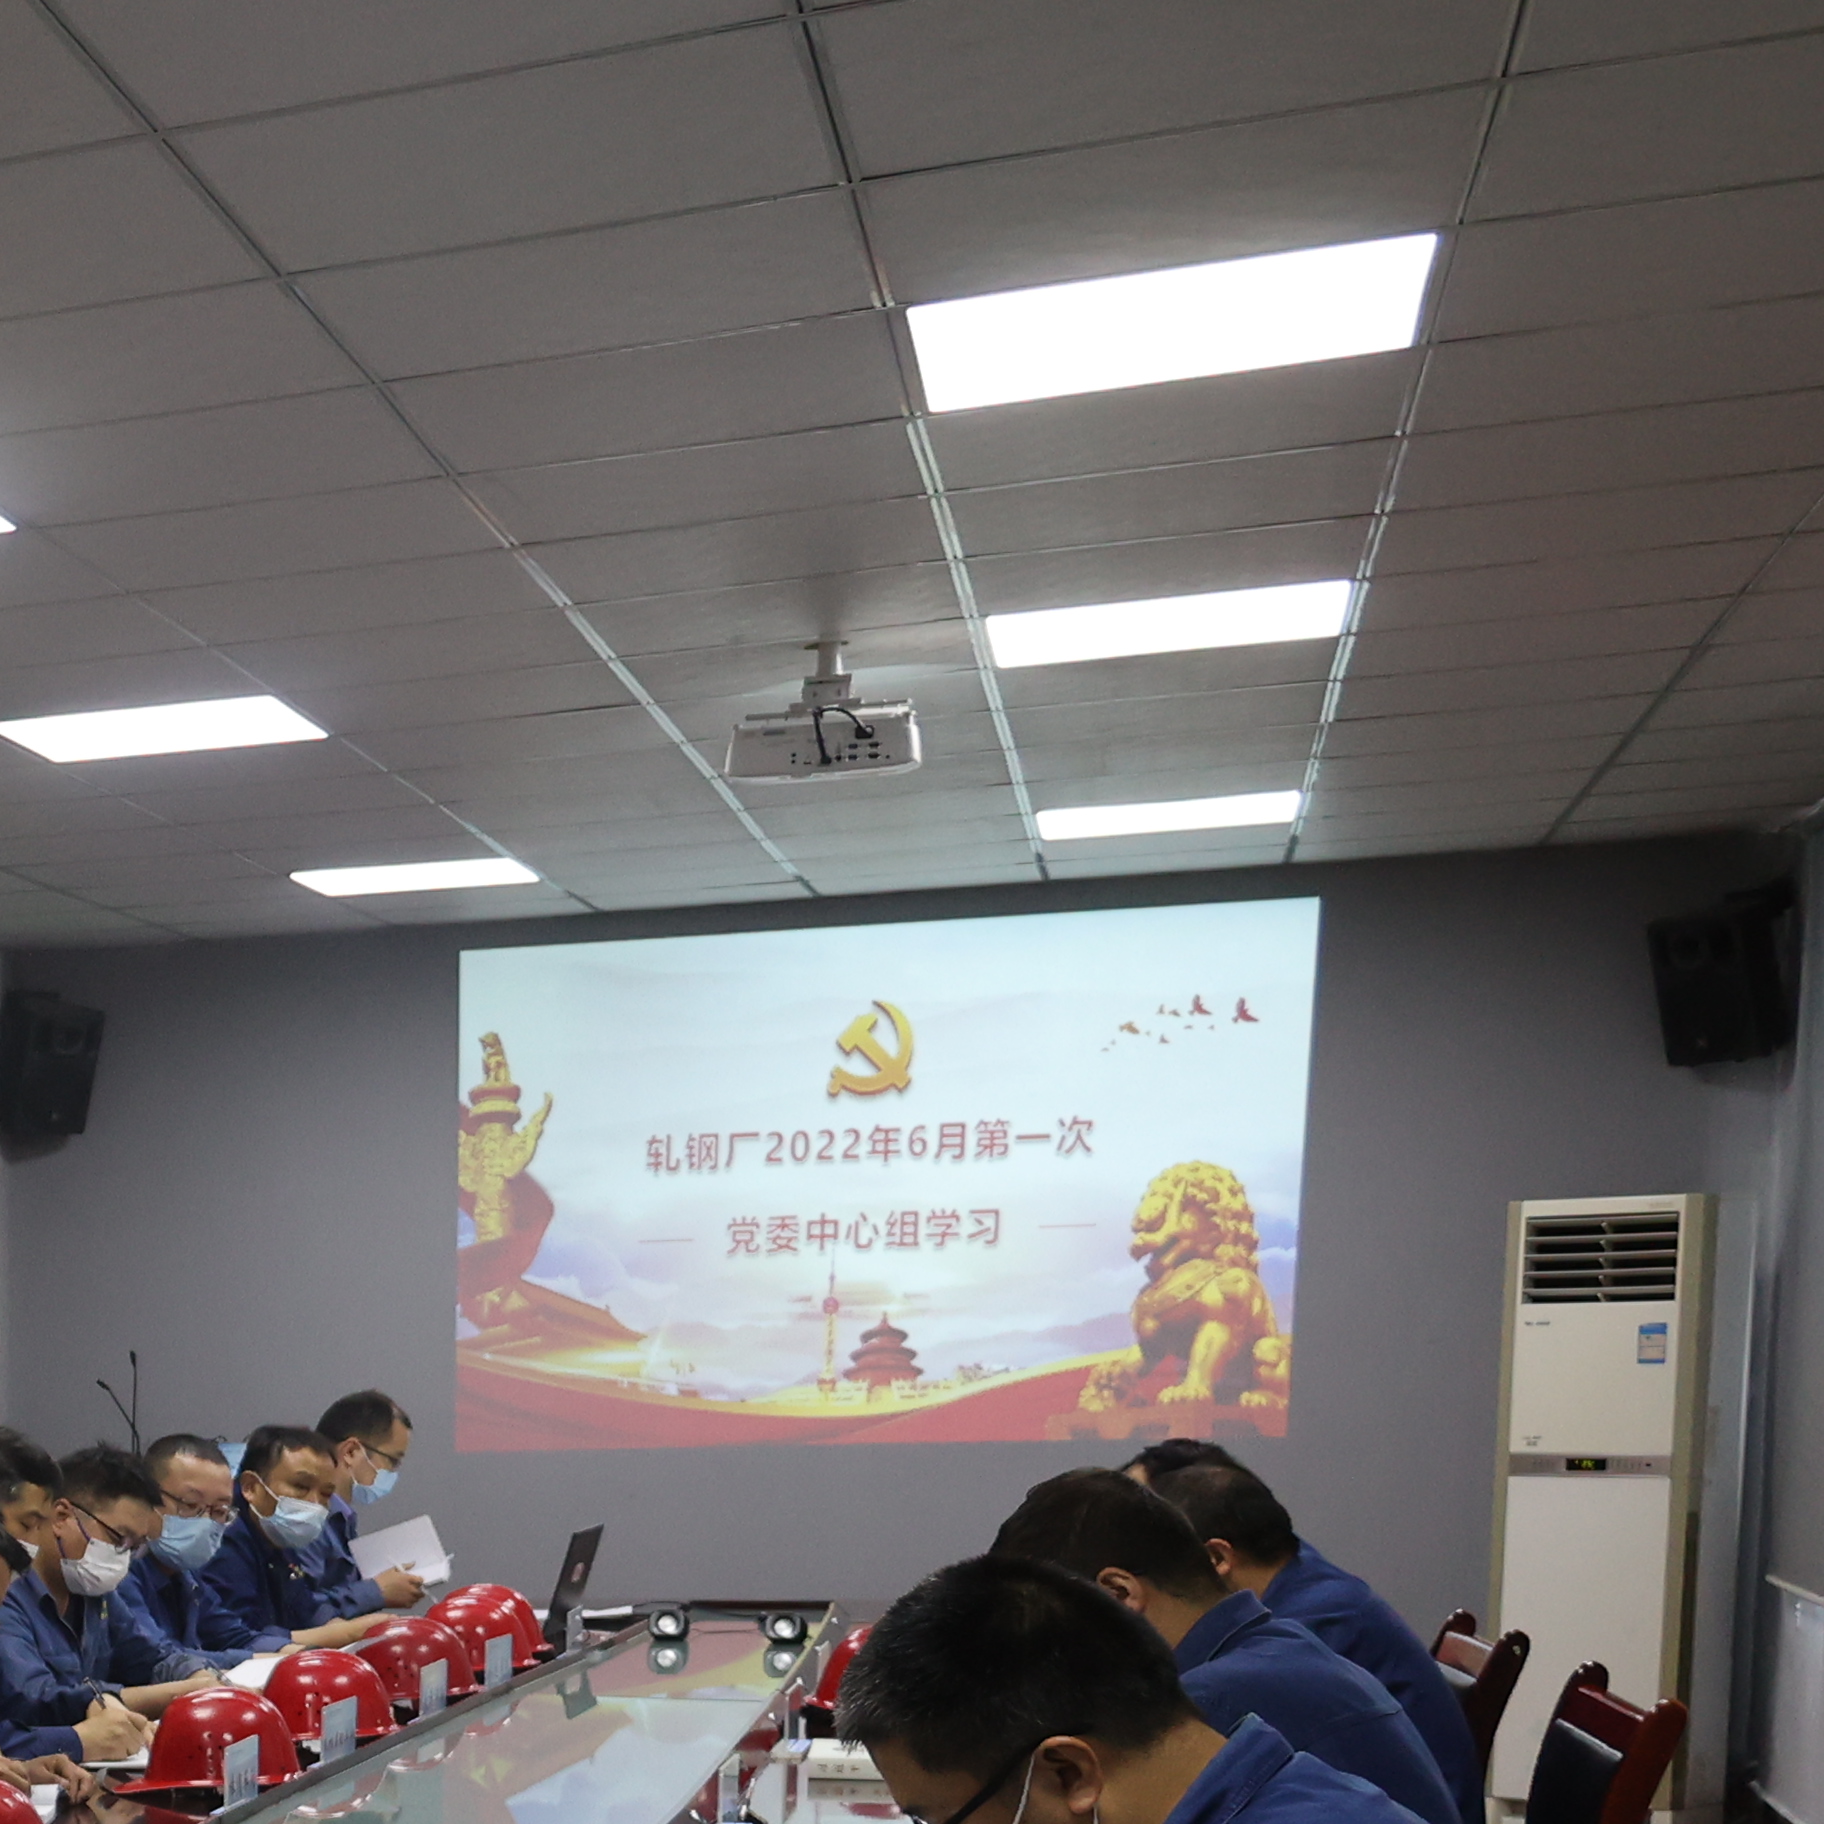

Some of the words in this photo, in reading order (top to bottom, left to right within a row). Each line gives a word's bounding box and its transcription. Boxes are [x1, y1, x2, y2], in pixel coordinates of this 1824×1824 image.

[645, 1116, 1095, 1175] 轧钢厂2022年6月第一次
[726, 1207, 1003, 1257] 党委中心组学习
